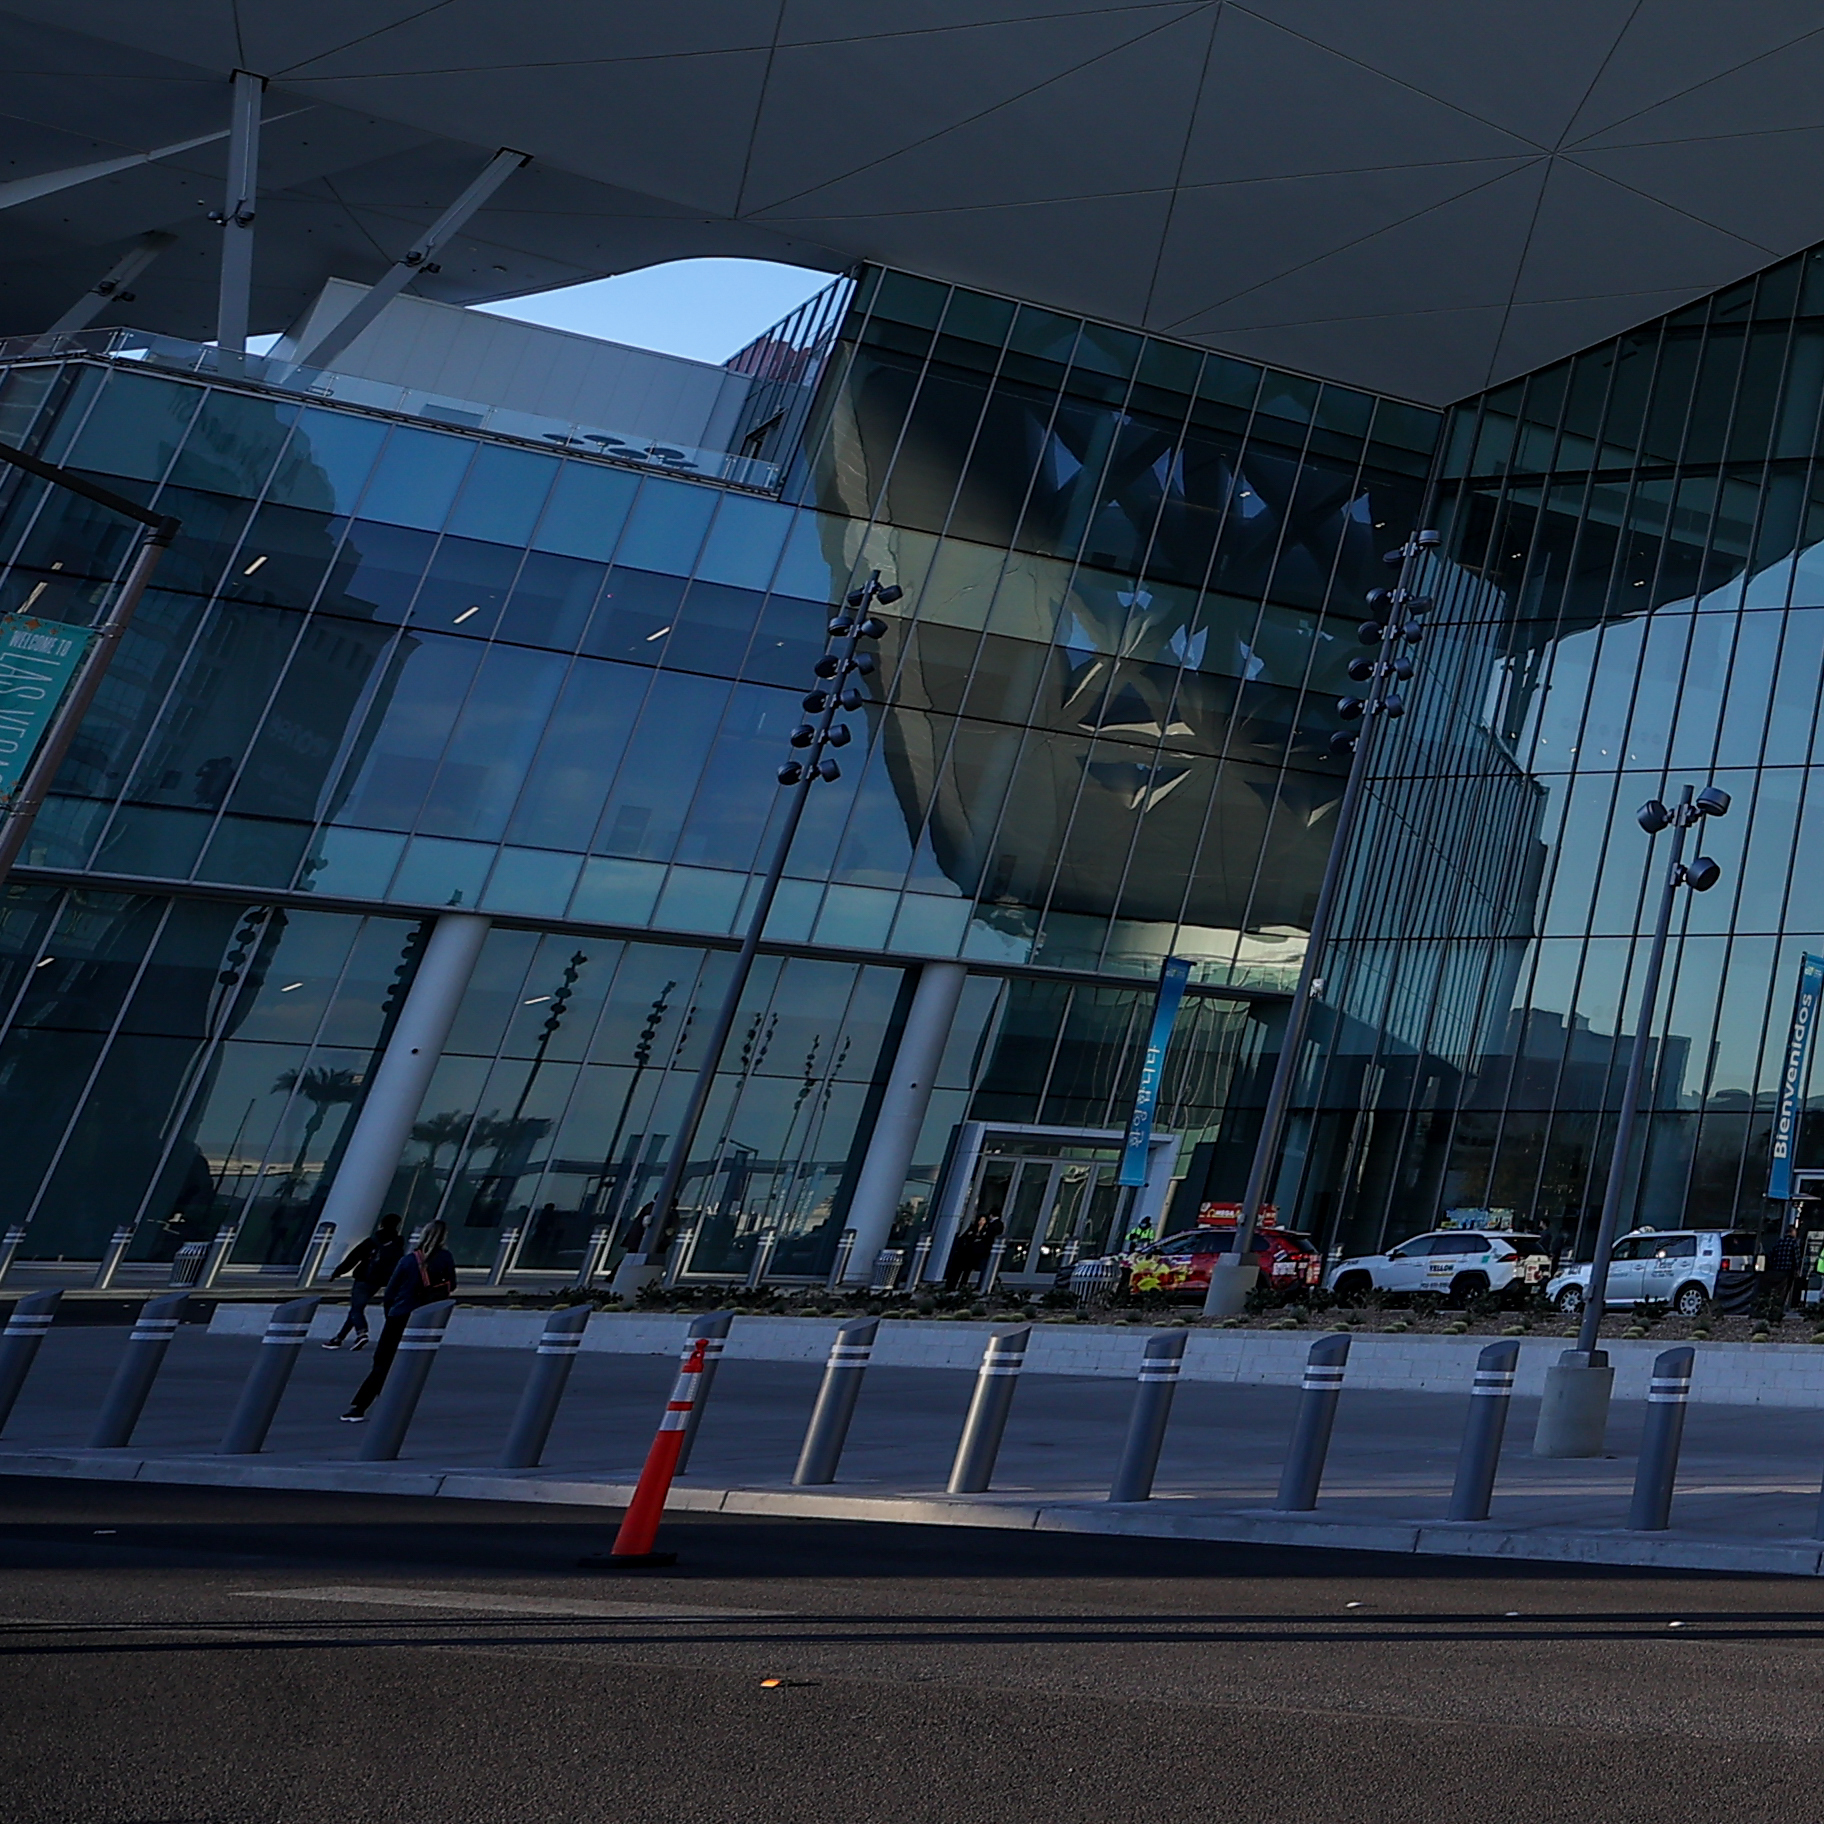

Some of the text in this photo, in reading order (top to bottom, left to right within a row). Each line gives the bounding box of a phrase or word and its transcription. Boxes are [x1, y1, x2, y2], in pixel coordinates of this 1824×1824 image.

[8, 630, 58, 656] WELCOME
[1129, 1044, 1161, 1149] 환영합니다
[1774, 993, 1813, 1159] Bienvenidos
